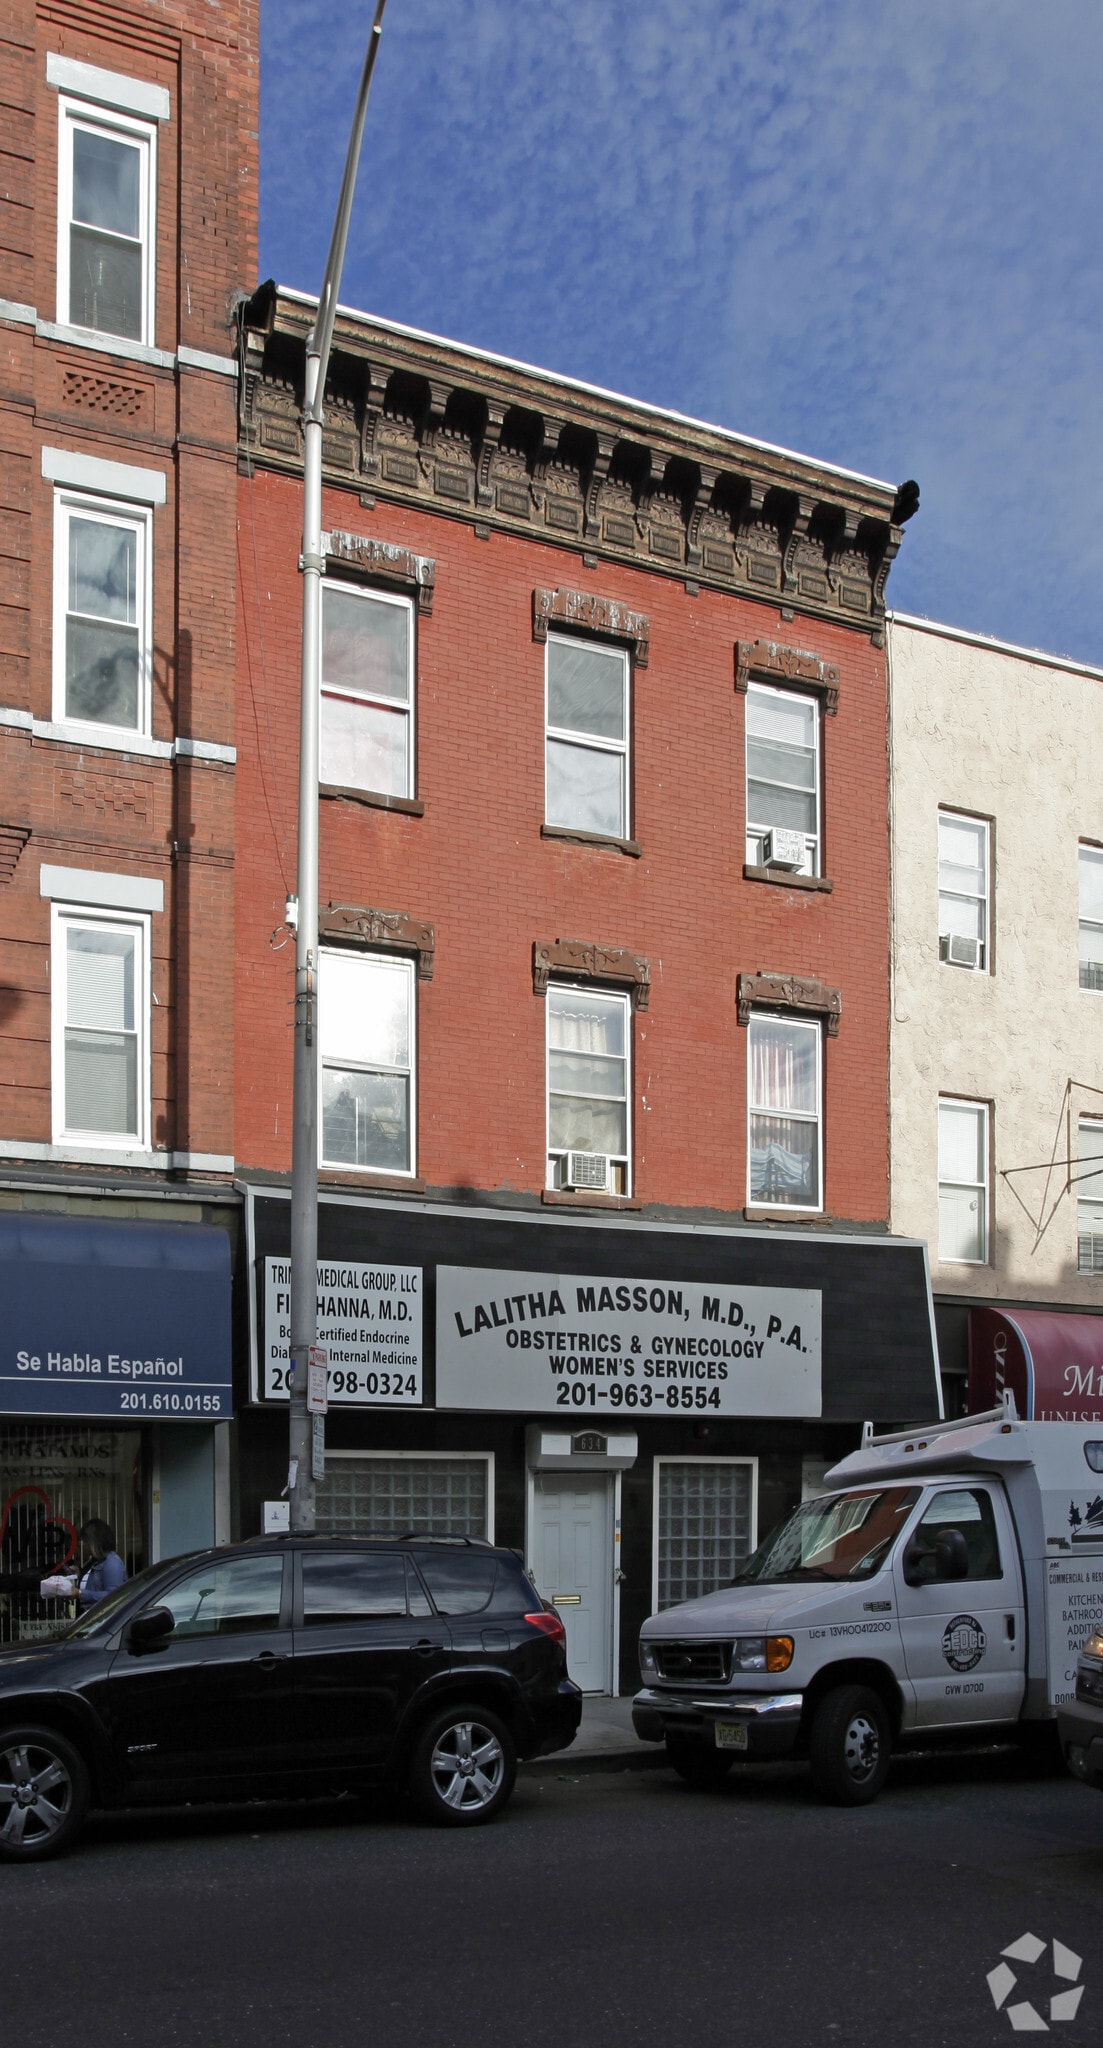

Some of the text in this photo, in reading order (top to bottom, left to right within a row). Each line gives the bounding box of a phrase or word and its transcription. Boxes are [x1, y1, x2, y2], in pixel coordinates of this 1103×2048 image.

[316, 1268, 359, 1290] MEDICAL
[362, 1271, 397, 1293] GROUP,
[401, 1274, 417, 1293] LLC
[316, 1296, 374, 1320] HANNA,
[379, 1300, 413, 1321] M.D.
[455, 1286, 808, 1354] LALITHA MASSON, M.D., P.A.
[360, 1329, 410, 1345] Endocrine
[506, 1328, 765, 1359] OBSTETRICS & GYNECOLOGY
[16, 1351, 183, 1379] Se Habla Español
[329, 1348, 370, 1363] Internal
[372, 1350, 418, 1365] Medicine
[549, 1355, 729, 1380] WOMEN'S SERVICES
[120, 1392, 221, 1412] 201.610.0155
[556, 1382, 722, 1409] 201-963-8554
[581, 1437, 601, 1451] 634
[1049, 1573, 1085, 1585] COMMERCIAL
[809, 1630, 826, 1639] Lic#
[942, 1630, 987, 1651] SEDCO
[945, 1682, 984, 1695] GVW 10700
